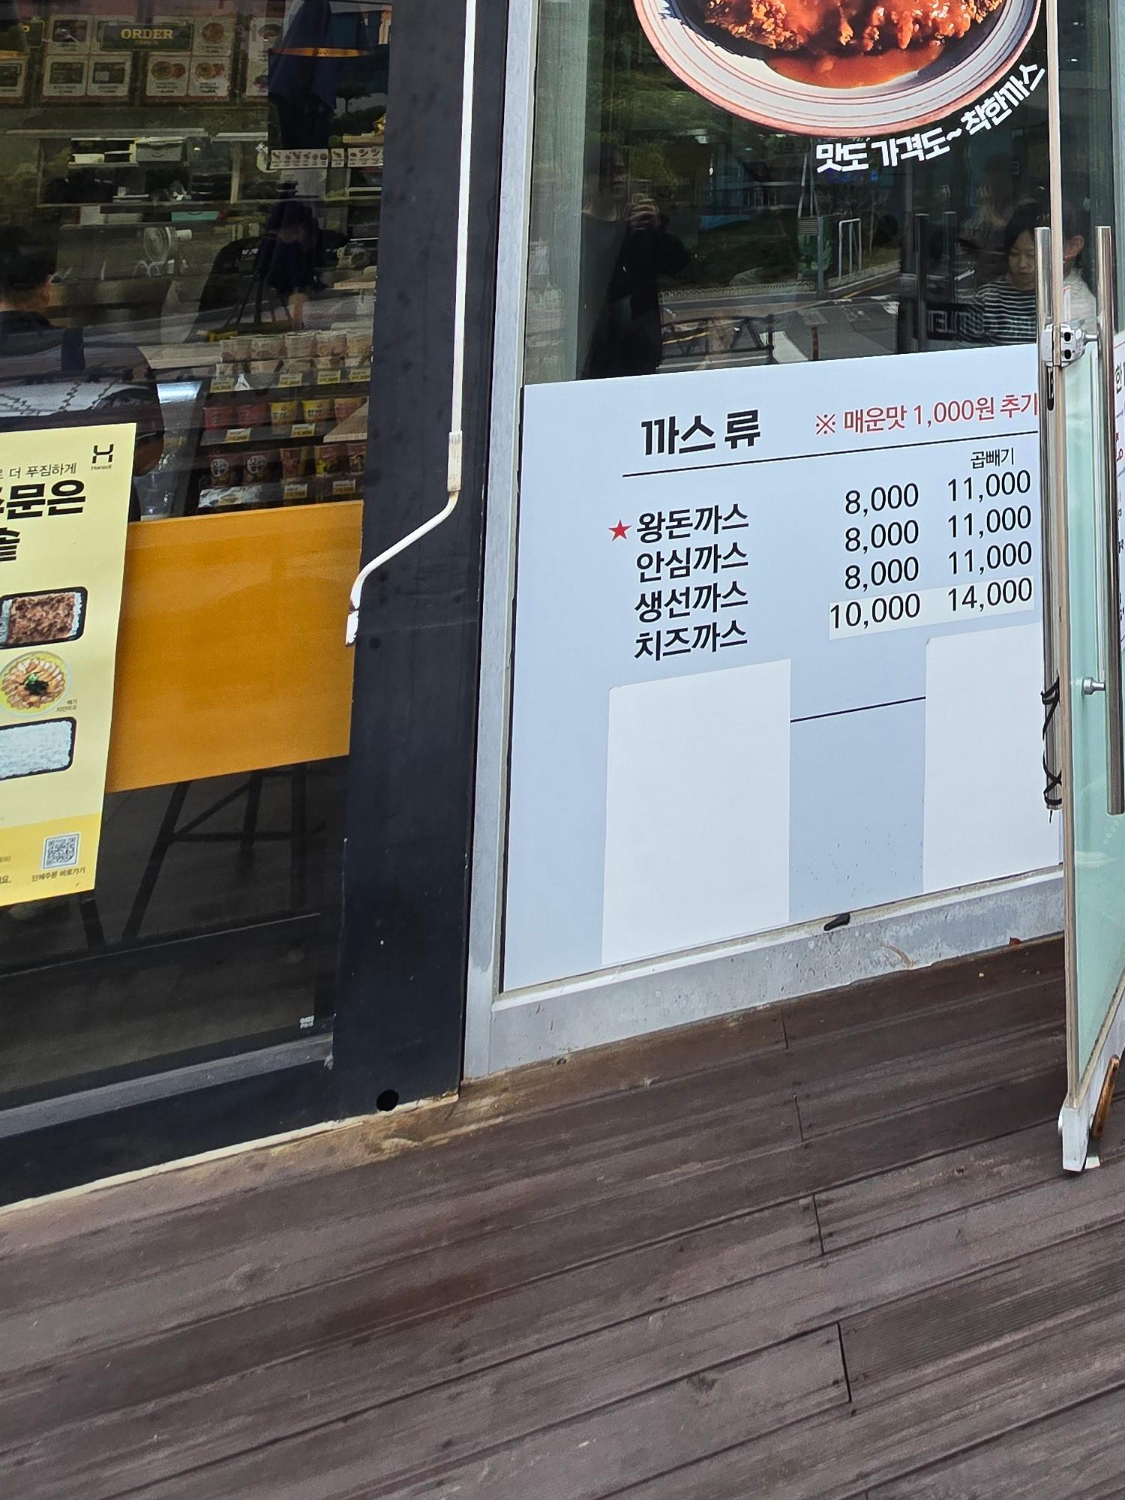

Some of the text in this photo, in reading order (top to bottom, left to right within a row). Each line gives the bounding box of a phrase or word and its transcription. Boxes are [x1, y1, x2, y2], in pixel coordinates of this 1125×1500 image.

[120, 28, 174, 40] ORDER
[815, 141, 870, 174] 맛도
[960, 61, 1046, 137] 착한까스
[640, 409, 762, 456] 까스 류
[843, 404, 908, 432] 매운맛
[913, 395, 995, 428] 1,000원
[9, 466, 21, 479] 더
[26, 462, 77, 478] 푸짐하게
[970, 447, 1015, 470] 곱빼기
[0, 479, 87, 520] 문은
[636, 469, 1032, 544] 왕돈까스 8,000 11,000
[636, 505, 1032, 583] 안심까스 8,000 11,000
[634, 541, 1033, 624] 생선까스 8,000 11,000
[634, 577, 1033, 662] 치즈까스 10,000 14,000
